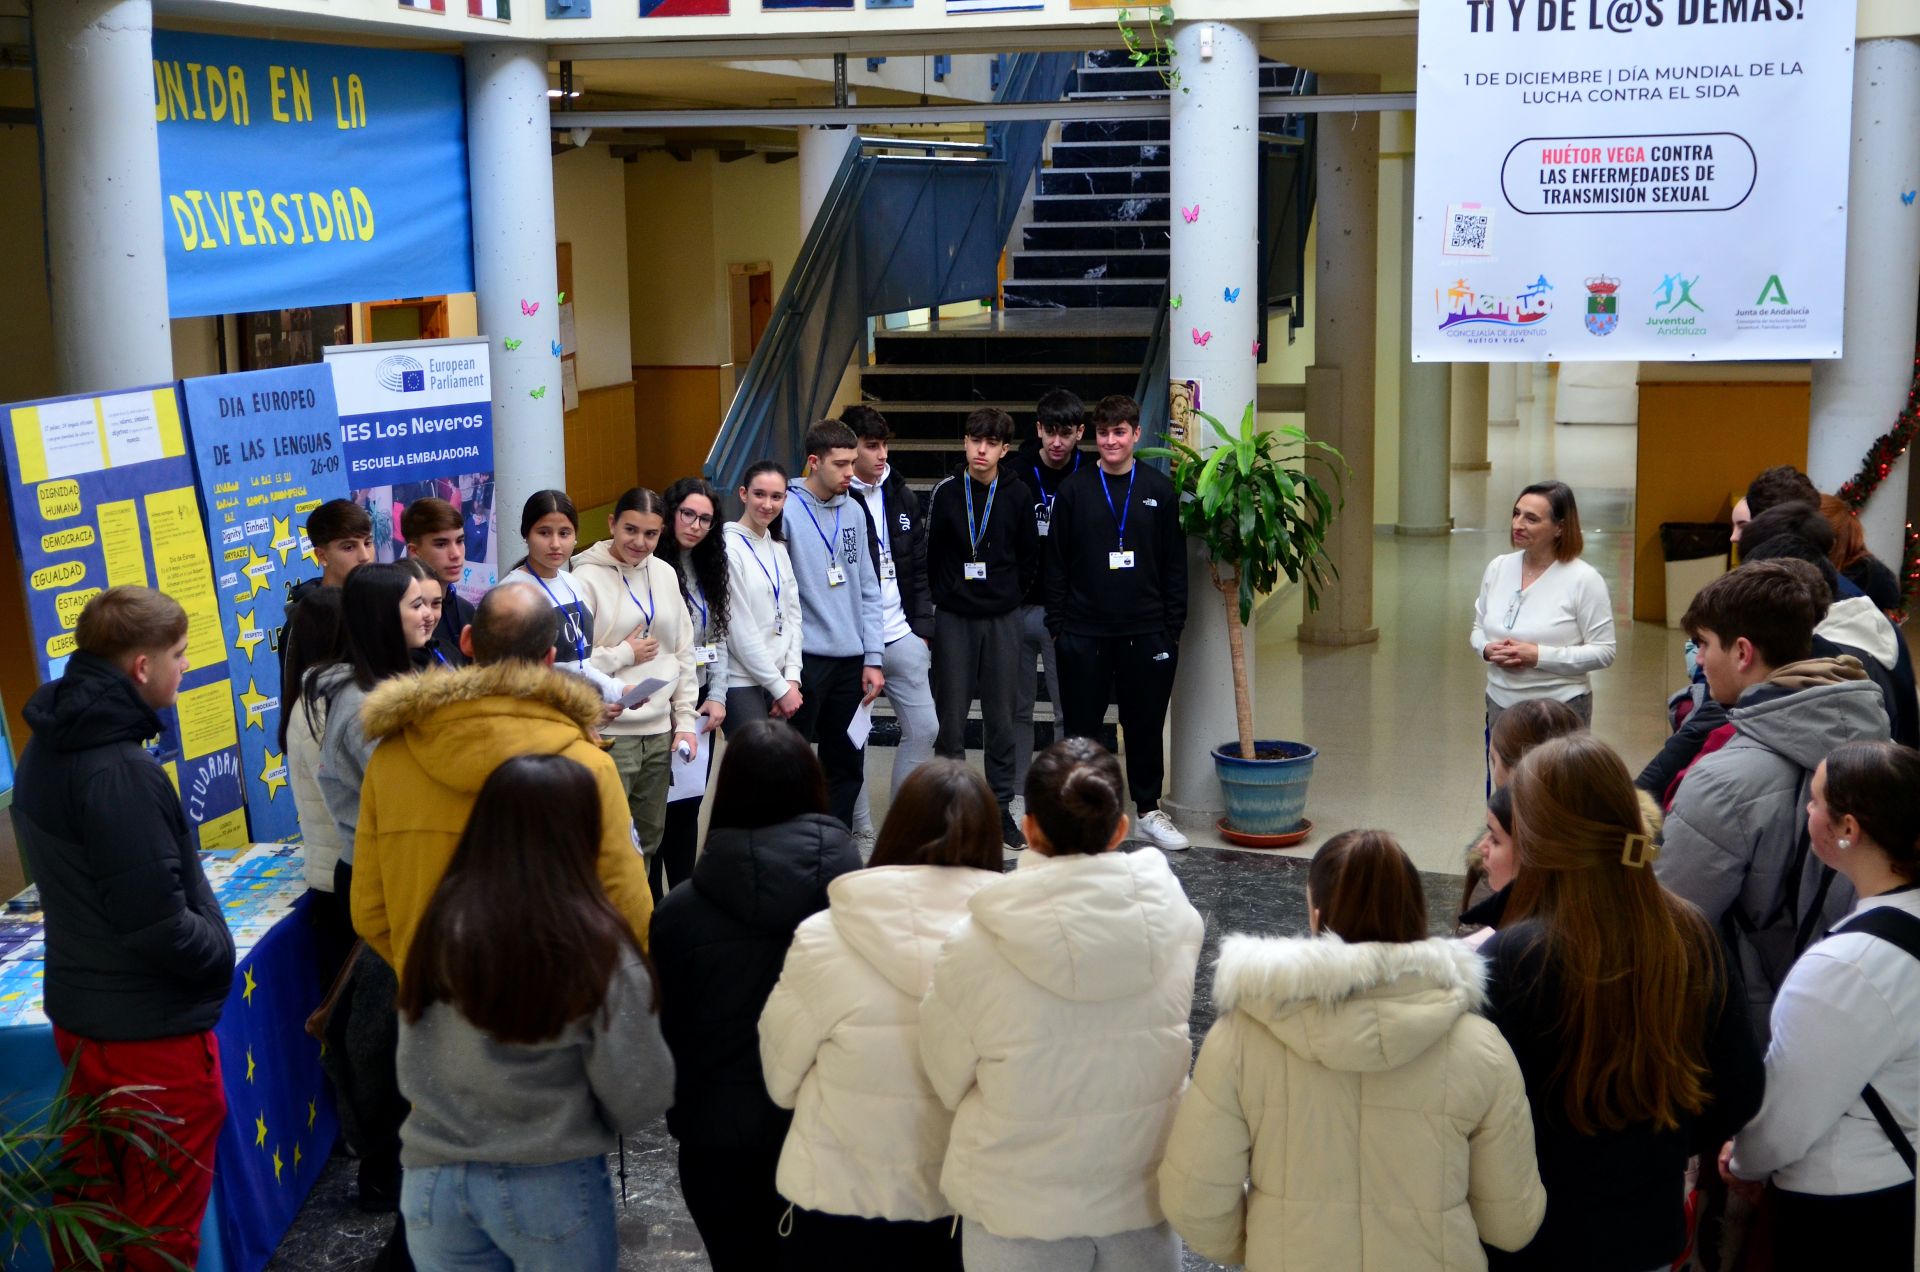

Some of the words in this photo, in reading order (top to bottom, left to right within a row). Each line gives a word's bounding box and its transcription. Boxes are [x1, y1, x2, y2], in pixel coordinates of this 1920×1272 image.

[1468, 0, 1494, 33] TI
[1508, 0, 1524, 32] Y
[1537, 0, 1576, 31] DE
[1588, 0, 1664, 33] L@S
[1464, 73, 1469, 86] 1
[1476, 73, 1499, 86] DE
[1505, 70, 1602, 86] DICIEMBRE
[1618, 65, 1649, 82] DÍA
[1656, 64, 1743, 81] MUNDIAL
[1750, 62, 1774, 77] DE
[1781, 61, 1803, 75] LA
[152, 60, 249, 126] UNIDA
[269, 65, 313, 123] EN
[332, 73, 366, 129] LA
[1523, 90, 1582, 104] LUCHA
[1588, 87, 1662, 102] CONTRA
[1669, 86, 1690, 100] EL
[1696, 84, 1740, 99] SIDA
[1542, 143, 1602, 165] HUÉTOR
[1607, 146, 1645, 163] VEGA
[1651, 145, 1713, 161] CONTRA
[1540, 169, 1566, 184] LAS
[1572, 166, 1690, 184] ENFERMEDADES
[1695, 165, 1715, 181] DE
[1542, 182, 1646, 204] TRANSMISIÓN
[1652, 185, 1709, 203] SEXUAL
[169, 187, 375, 251] DIVERSIDAD
[1645, 317, 1695, 326] Juventud
[1656, 326, 1707, 336] Andaluza
[429, 359, 475, 375] European
[430, 373, 484, 390] Parliament
[218, 397, 245, 418] DIA
[252, 388, 315, 413] EUROPEO
[340, 422, 371, 443] IES
[375, 421, 408, 439] Los
[411, 414, 483, 435] Neveros
[213, 444, 231, 466] DE
[241, 438, 265, 462] LAS
[273, 432, 332, 457] LENGUAS
[352, 455, 406, 472] ESCUELA
[407, 445, 479, 465] EMBAJADORA
[310, 455, 339, 475] 26-09
[39, 485, 80, 500] DIGNIDAD
[45, 503, 79, 516] HUMANA
[245, 519, 269, 533] Einheit
[43, 530, 93, 549] DEMOCRACIA
[33, 563, 82, 587] IGUALDAD
[57, 594, 88, 610] ESTADO
[52, 636, 76, 652] LIBER
[251, 700, 277, 712] DEMOCRACIA
